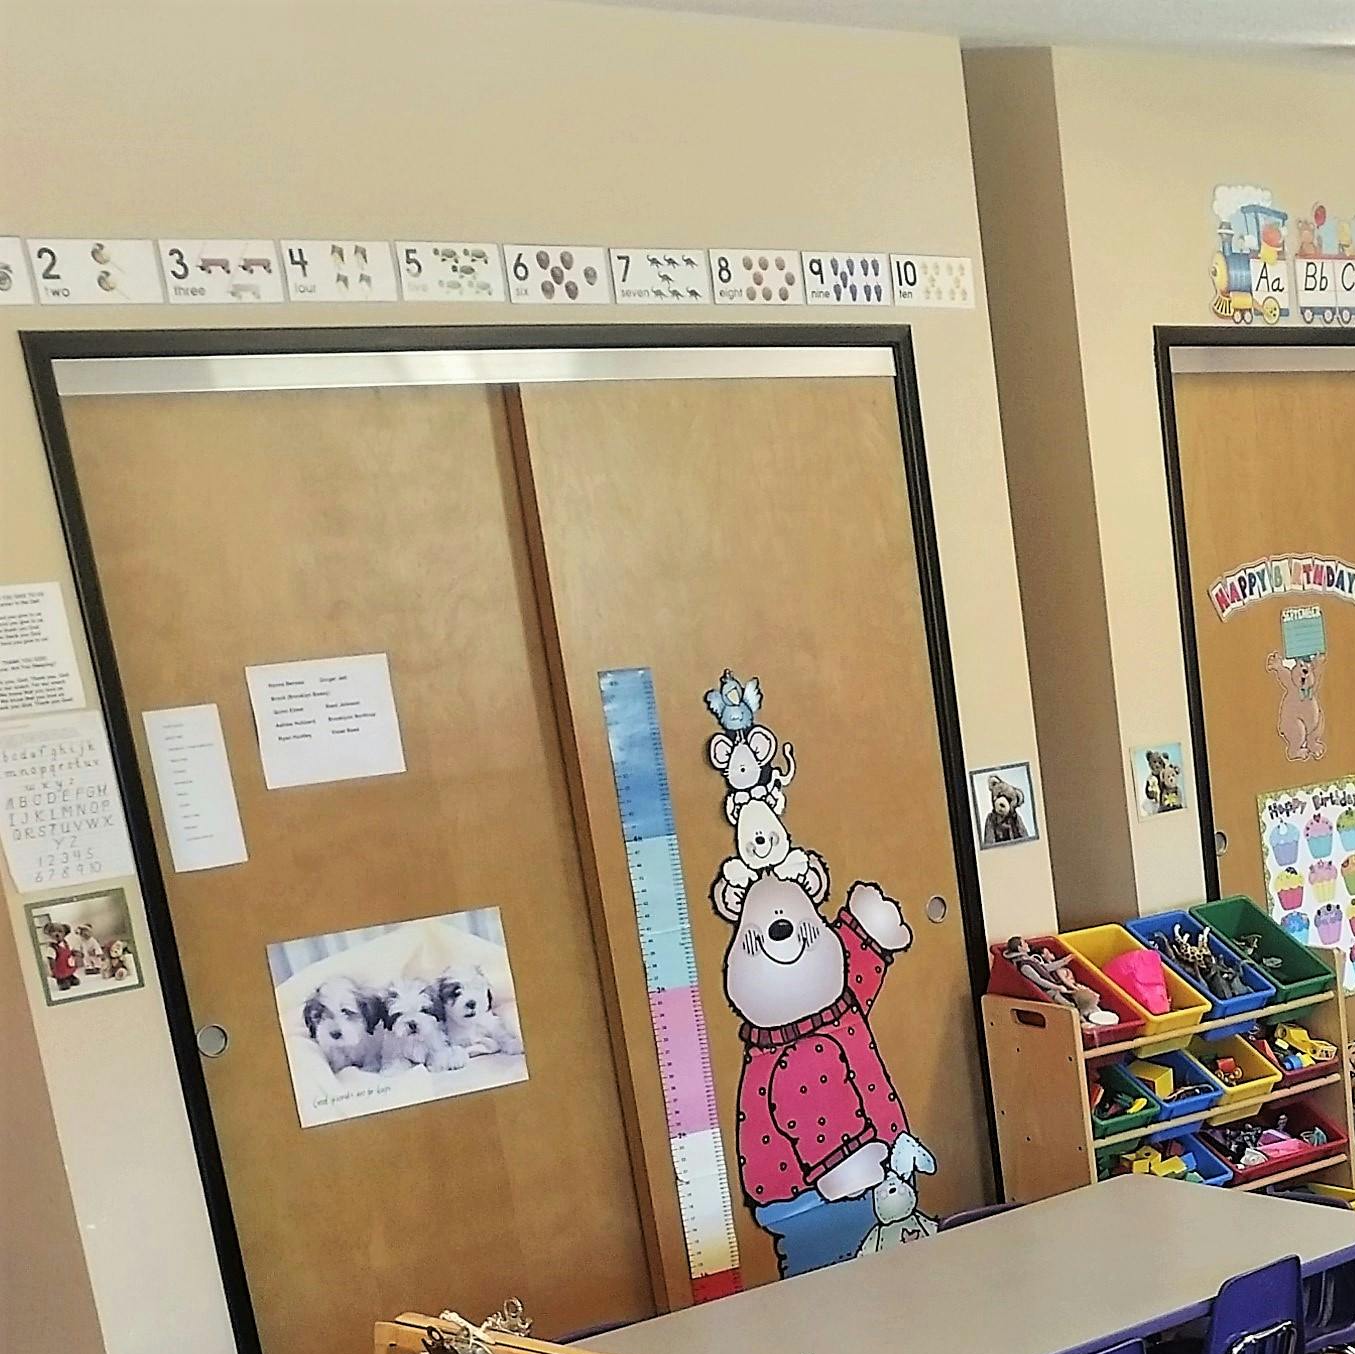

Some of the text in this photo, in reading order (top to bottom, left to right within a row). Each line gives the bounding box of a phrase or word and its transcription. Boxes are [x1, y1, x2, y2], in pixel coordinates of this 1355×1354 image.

[37, 247, 61, 281] 2
[170, 248, 190, 281] 3
[288, 248, 308, 277] 4
[405, 248, 423, 277] 5
[513, 253, 529, 281] 6
[616, 255, 631, 283] 7
[718, 257, 733, 284] 8
[809, 258, 825, 285] 9
[897, 260, 917, 287] 10
[173, 284, 206, 298] three
[1255, 262, 1285, 293] Aa
[1304, 262, 1329, 292] Bb
[514, 286, 529, 297] six
[620, 288, 650, 299] seven
[719, 287, 744, 300] eight
[811, 288, 831, 299] nine
[899, 289, 914, 299] ten
[1214, 568, 1268, 614] HAPPY
[1268, 798, 1307, 820] Happy
